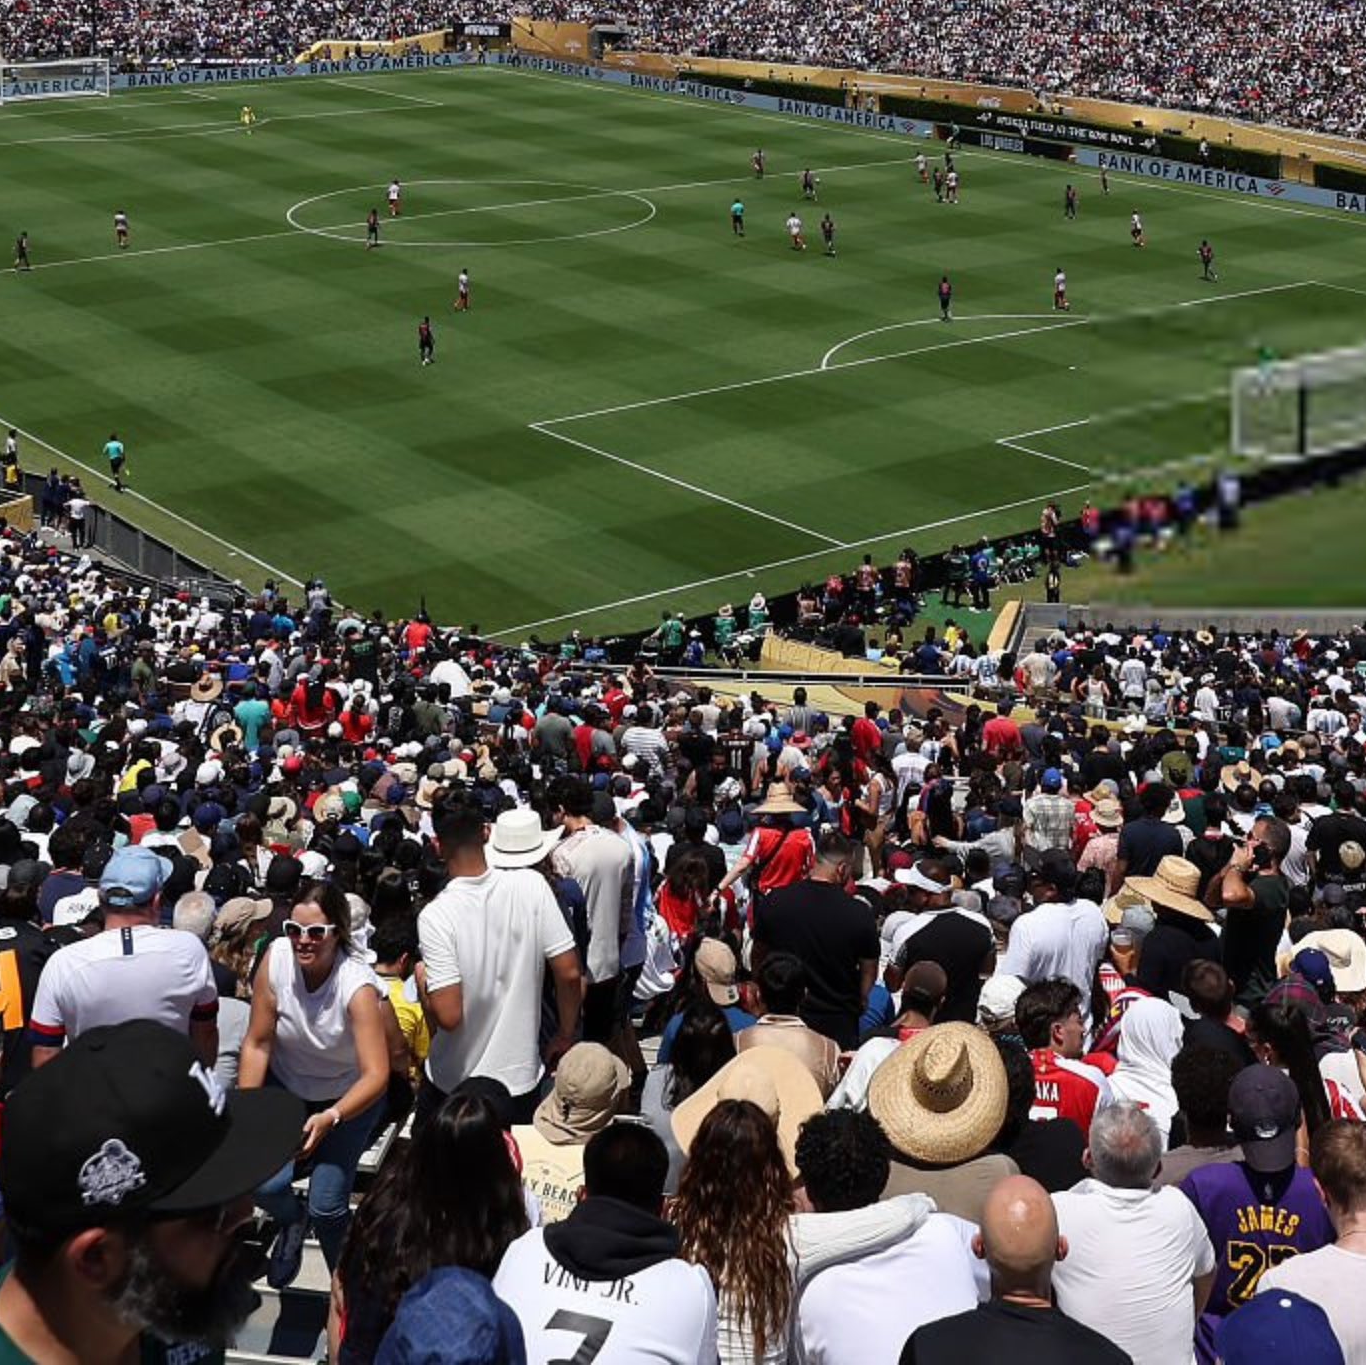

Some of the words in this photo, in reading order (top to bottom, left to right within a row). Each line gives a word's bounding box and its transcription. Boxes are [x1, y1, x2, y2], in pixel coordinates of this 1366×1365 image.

[310, 60, 353, 74] BANK
[357, 57, 376, 71] OF
[380, 53, 452, 69] AMERICA
[499, 53, 532, 68] BAK
[10, 78, 93, 97] AMERICA
[128, 72, 175, 86] BANK
[179, 69, 200, 83] OF
[204, 66, 277, 81] AMERICA
[630, 74, 660, 92] BANK
[663, 79, 677, 93] OF
[679, 81, 734, 103] AMERICA
[779, 99, 812, 117] BANK
[815, 105, 831, 120] OF
[835, 107, 896, 132] AMERICA
[1068, 126, 1086, 138] THE
[1098, 152, 1144, 174] BANK
[1149, 160, 1171, 177] OF
[1176, 166, 1259, 195] AMERICA
[542, 1184, 580, 1204] BEAC
[1237, 1205, 1299, 1236] JAMES
[544, 1262, 590, 1292] VINI
[544, 1308, 614, 1365] 7
